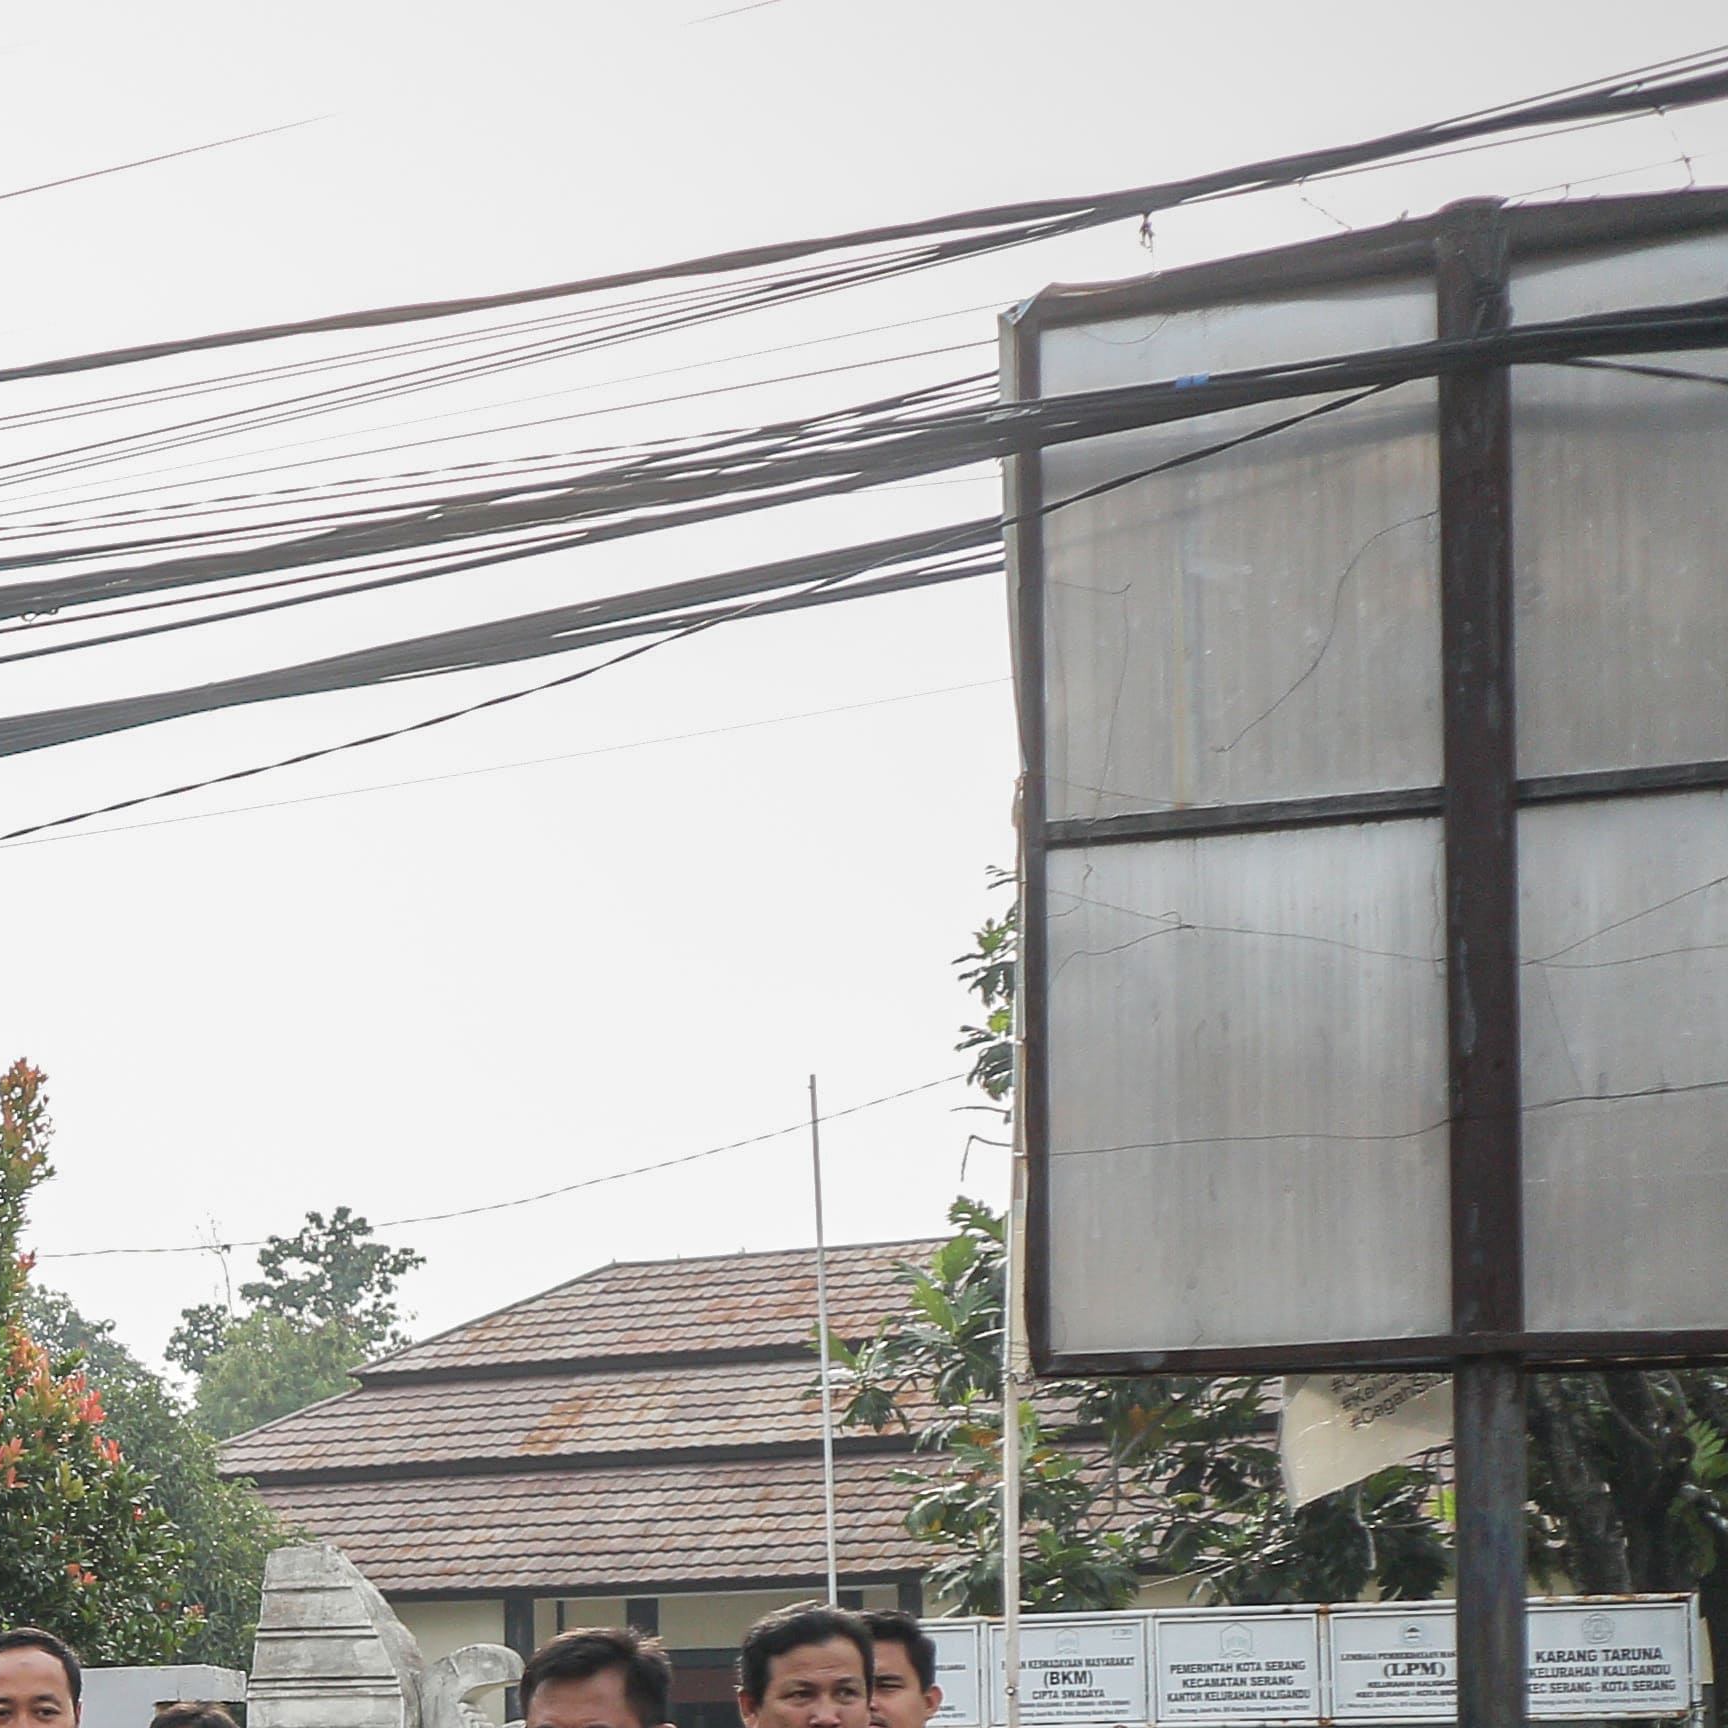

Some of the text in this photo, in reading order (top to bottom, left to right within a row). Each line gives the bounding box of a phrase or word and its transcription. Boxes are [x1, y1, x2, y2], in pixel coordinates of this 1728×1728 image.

[1535, 1647, 1663, 1663] KARANG TARUNA
[1170, 1660, 1306, 1675] PEMERINTAH KOTA SERANG
[1384, 1661, 1446, 1679] (LPM)
[1529, 1664, 1671, 1678] KELURAHAN KALIGANDU
[1043, 1670, 1094, 1688] (BKM)
[1182, 1676, 1294, 1688] KECAMATAN SERANG
[1550, 1681, 1592, 1693] SERANG
[1601, 1680, 1630, 1692] KOTA
[1632, 1679, 1676, 1691] SERANG
[1032, 1689, 1105, 1700] CIPTA SWADAYA
[1167, 1689, 1311, 1702] KANTOR KELURAHAN KALIGANDU
